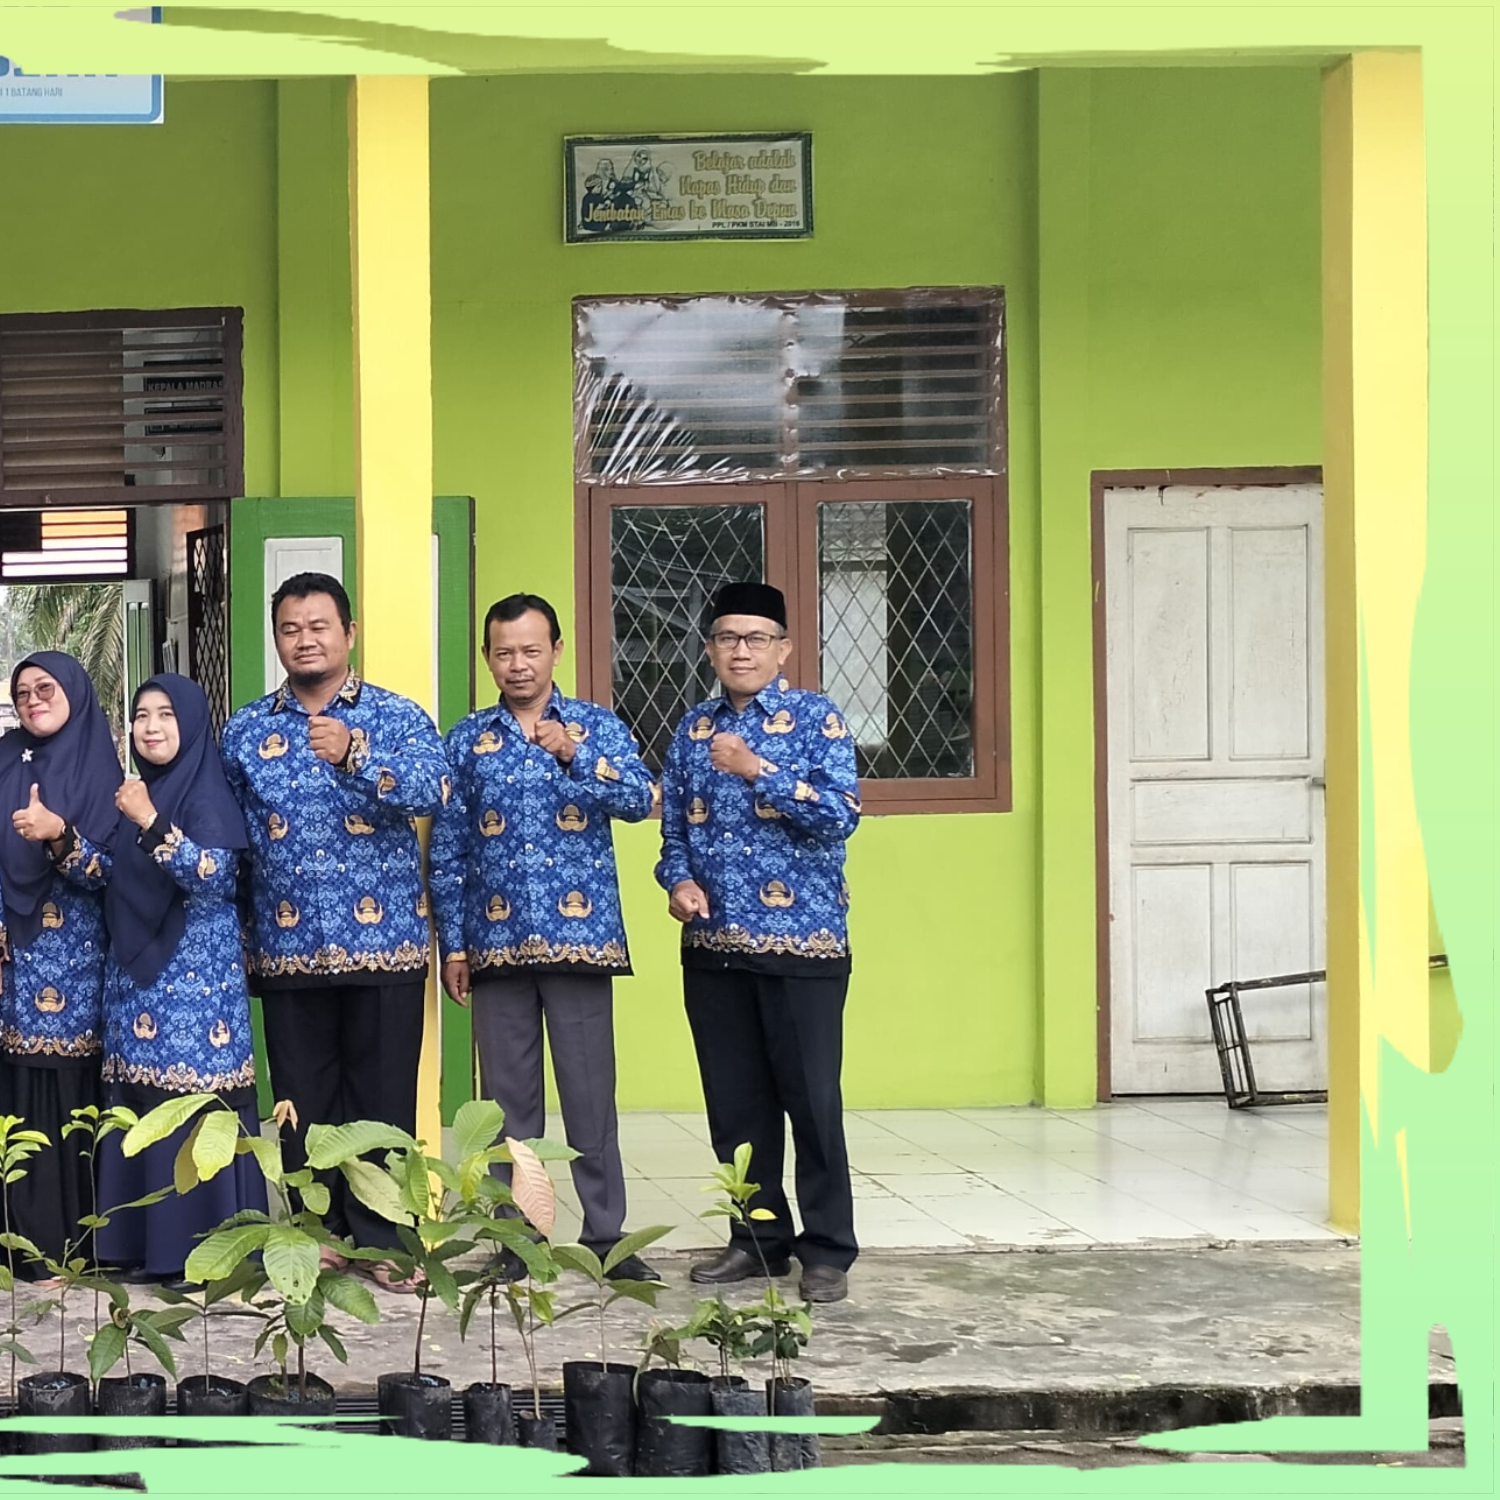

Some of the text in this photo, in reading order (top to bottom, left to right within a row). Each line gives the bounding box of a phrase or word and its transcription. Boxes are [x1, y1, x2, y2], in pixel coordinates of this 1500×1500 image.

[5, 87, 9, 97] 1
[11, 87, 42, 97] BATANG
[44, 87, 63, 97] HARI
[692, 149, 796, 174] Belajar adalah
[725, 174, 765, 199] Hidup
[769, 173, 797, 194] dan
[652, 201, 685, 221] Emas
[690, 199, 707, 220] ke
[752, 199, 797, 223] Depan
[148, 382, 184, 392] KEPALA
